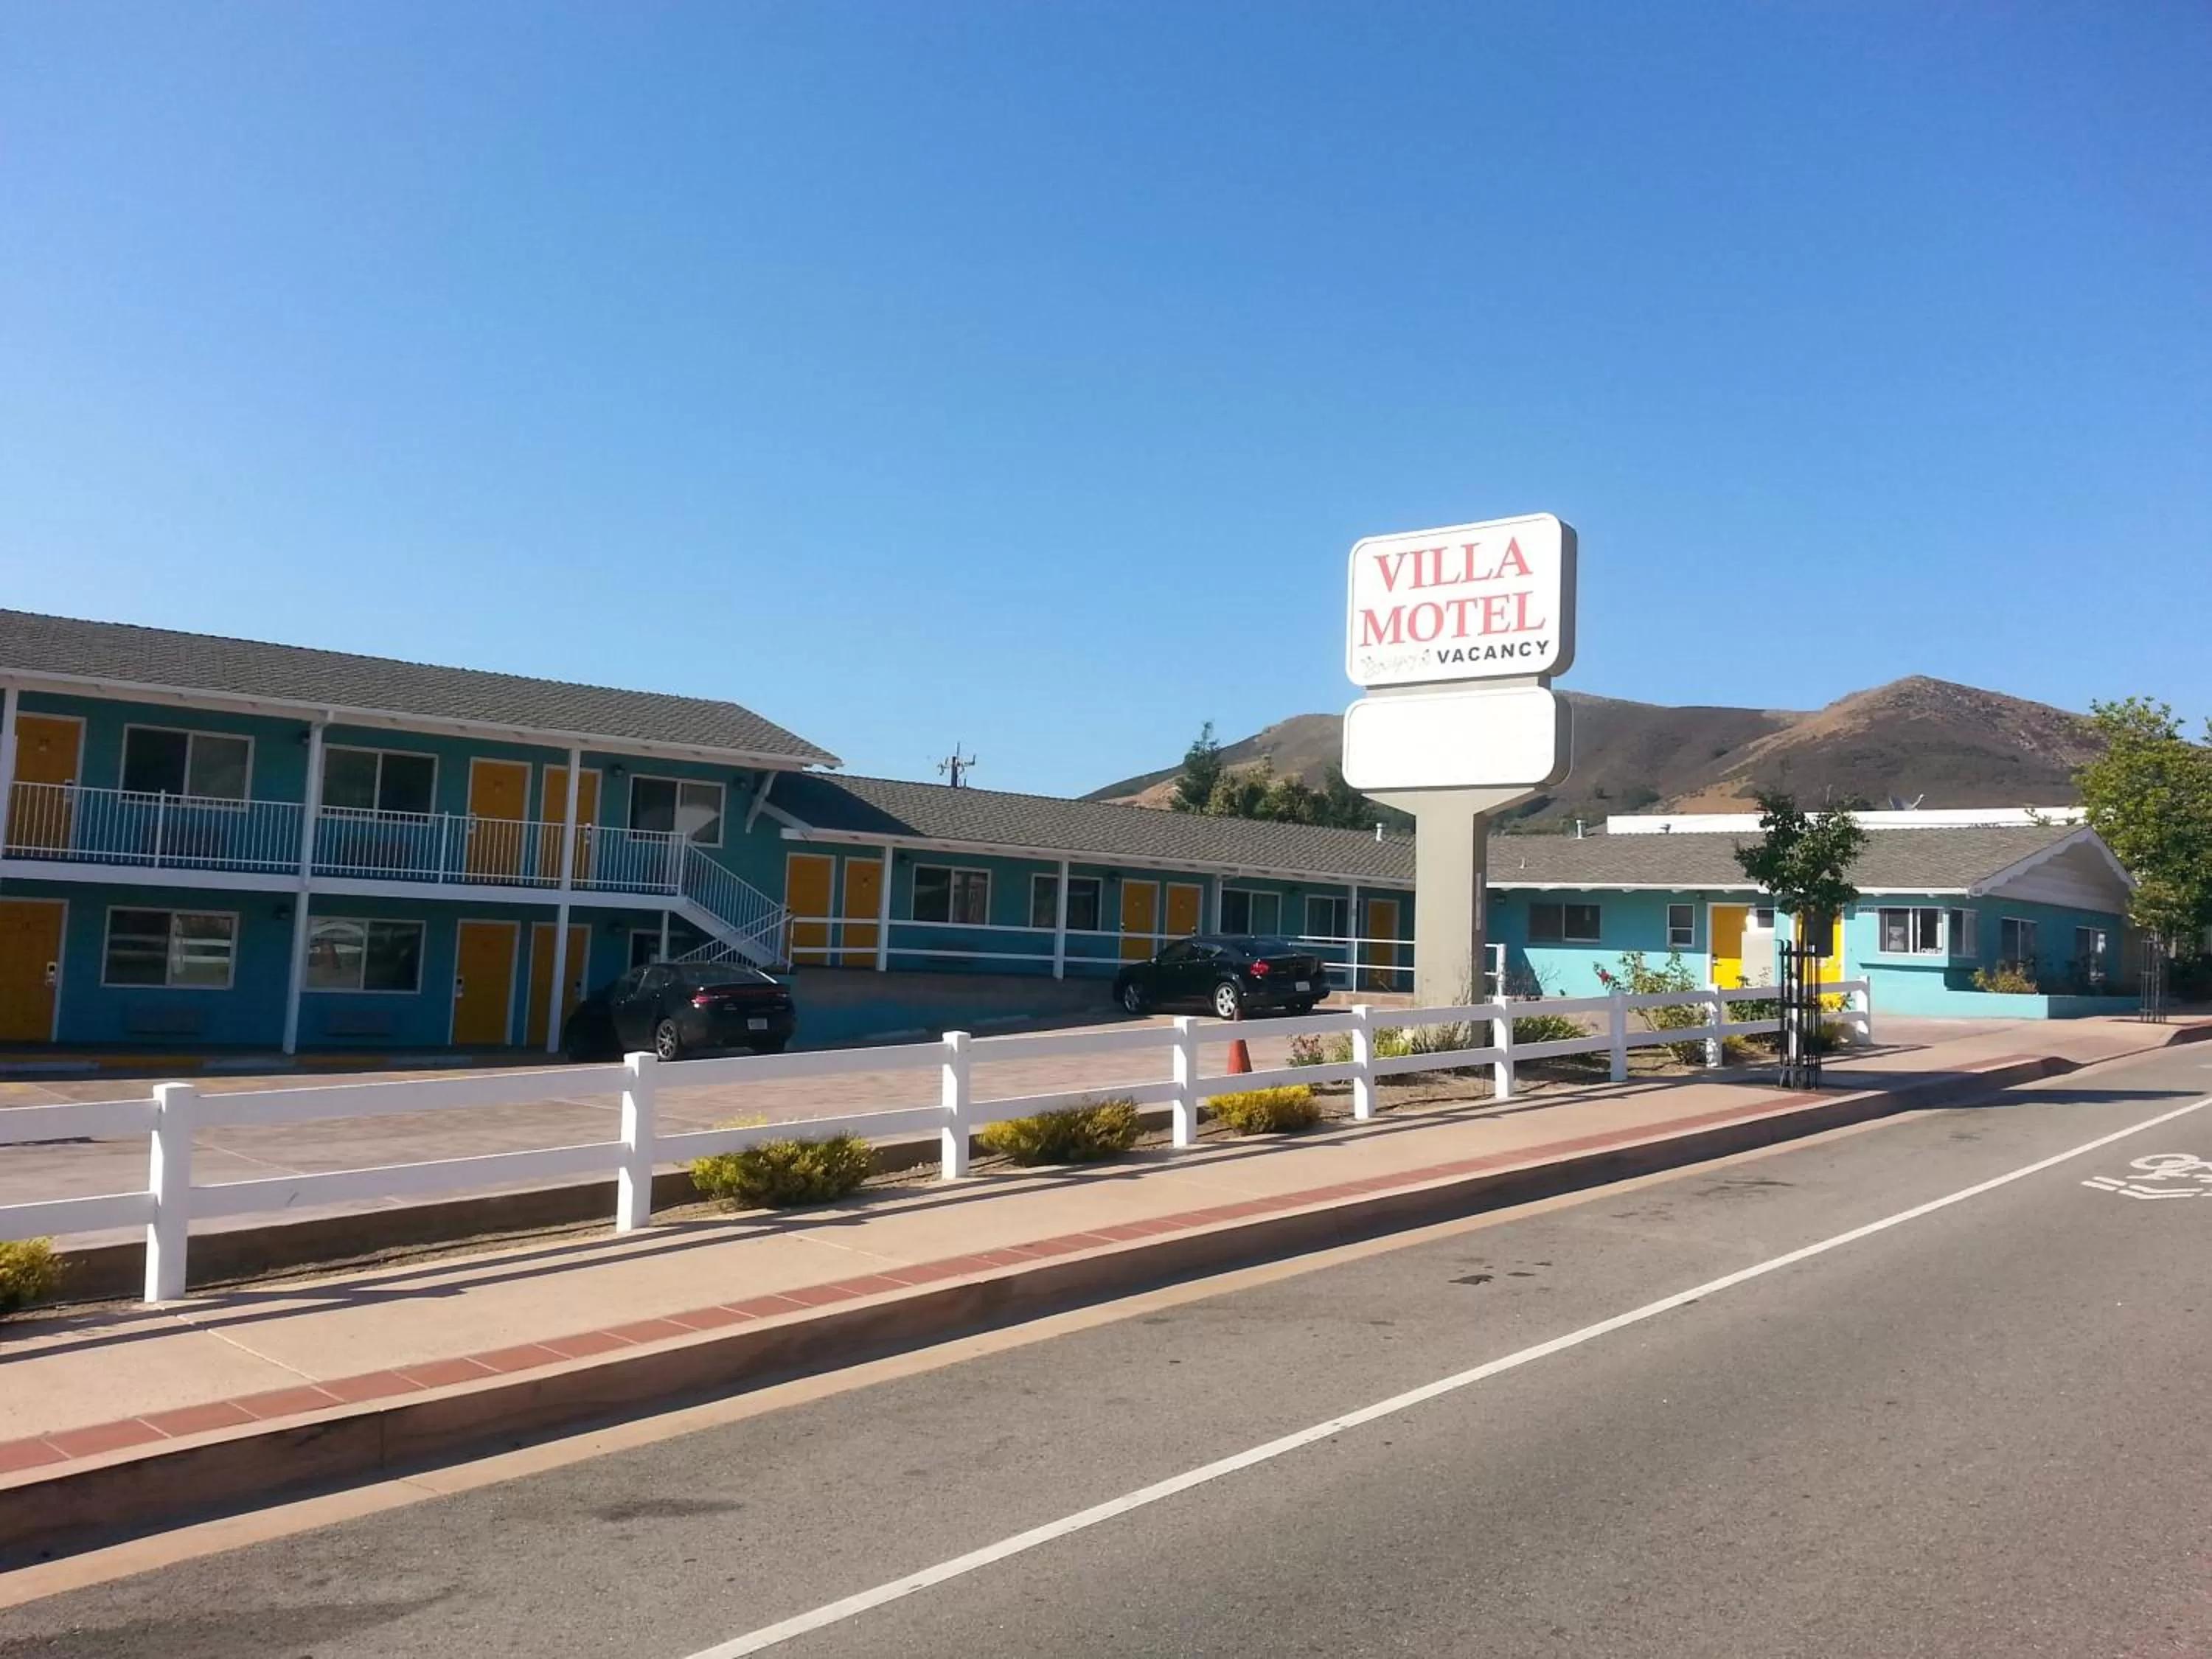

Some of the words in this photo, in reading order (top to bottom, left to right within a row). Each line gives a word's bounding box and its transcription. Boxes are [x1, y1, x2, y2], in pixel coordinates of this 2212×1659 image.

[1374, 537, 1533, 592] VILLA
[1360, 591, 1546, 647] MOTEL
[1437, 640, 1550, 664] VACANCY
